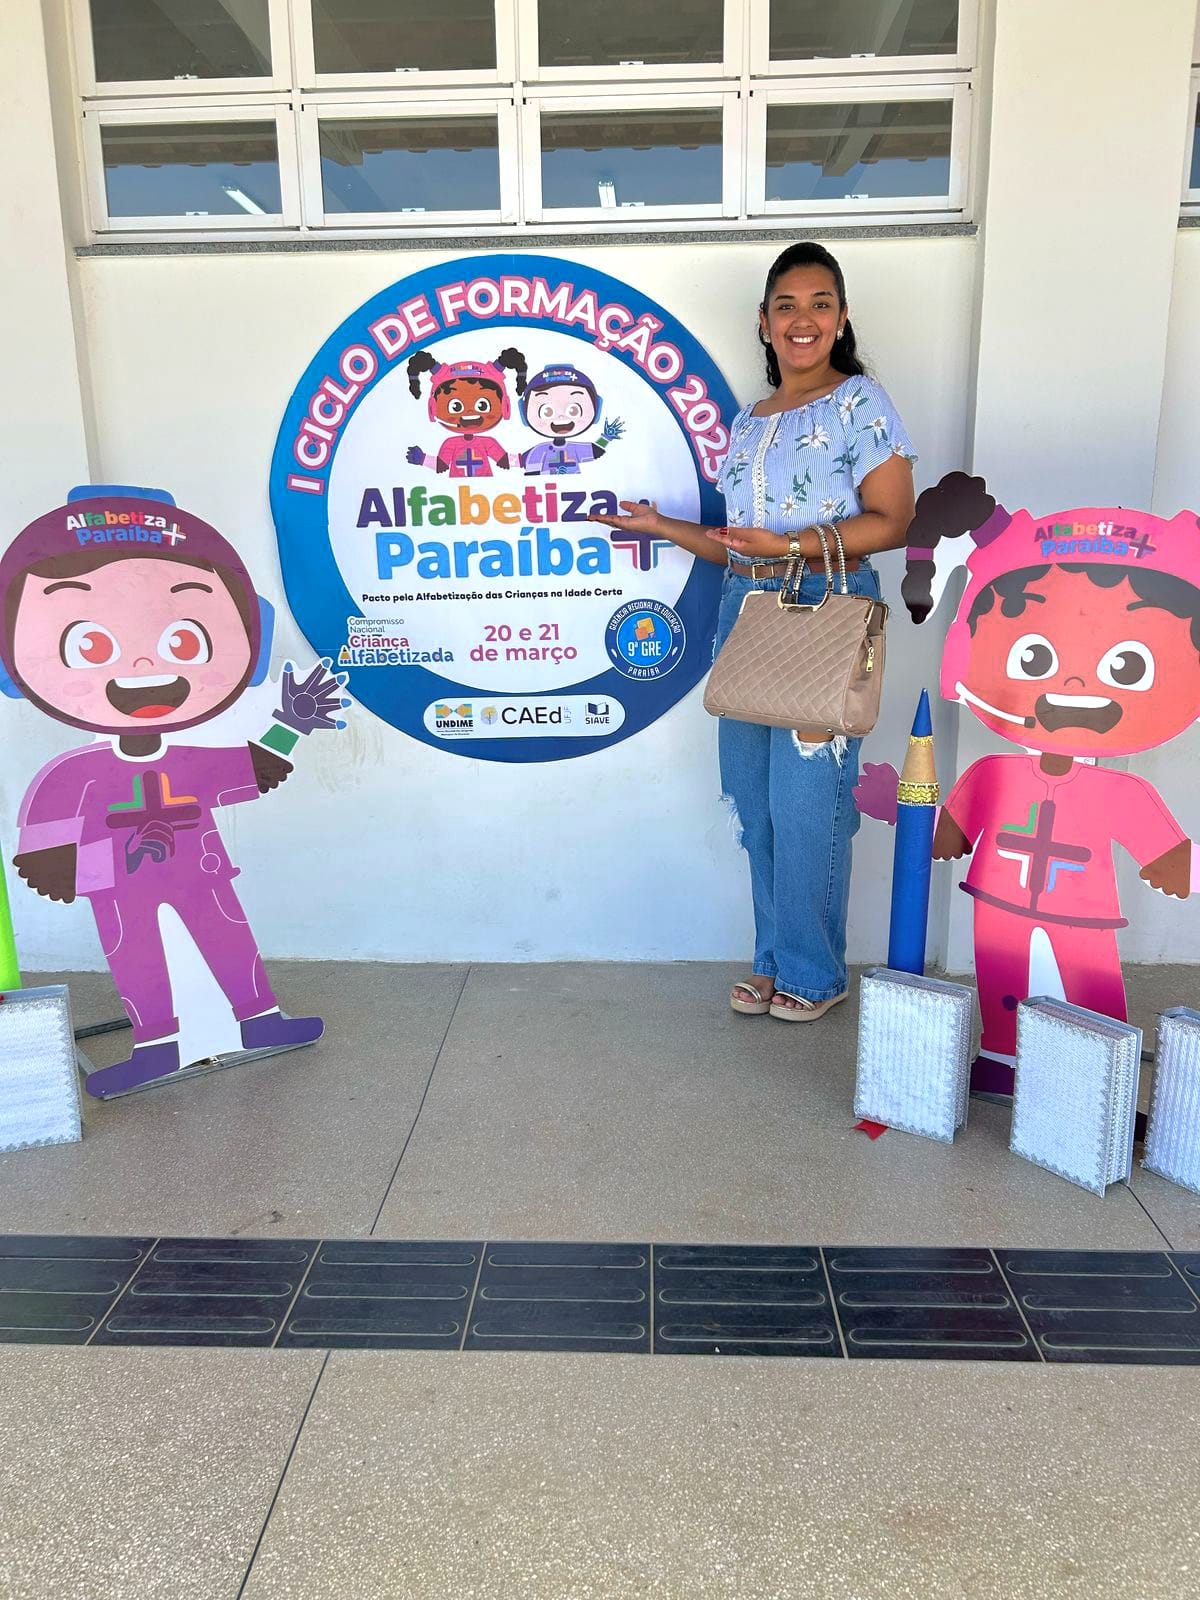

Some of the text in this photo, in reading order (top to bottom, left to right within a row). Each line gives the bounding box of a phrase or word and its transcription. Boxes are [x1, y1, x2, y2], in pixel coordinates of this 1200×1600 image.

[369, 295, 439, 360] DE
[437, 277, 683, 383] FORMAÇÃO
[294, 344, 378, 470] CICLO
[290, 476, 322, 493] I
[356, 483, 618, 528] Alfabetiza
[66, 511, 167, 531] Alfabetiza
[1034, 521, 1137, 542] Alfabetiza
[376, 527, 611, 580] Paraíba
[362, 588, 623, 603] Pacto pela Alfabetização das Crianças na Idade Certa
[349, 617, 405, 626] Compromisso
[349, 634, 410, 650] Criança
[484, 624, 560, 641] 20 e 21
[470, 644, 578, 665] de março
[641, 640, 662, 656] GRE
[435, 719, 474, 728] UNDIME
[501, 706, 562, 725] CAEd
[585, 716, 610, 725] SIAVE
